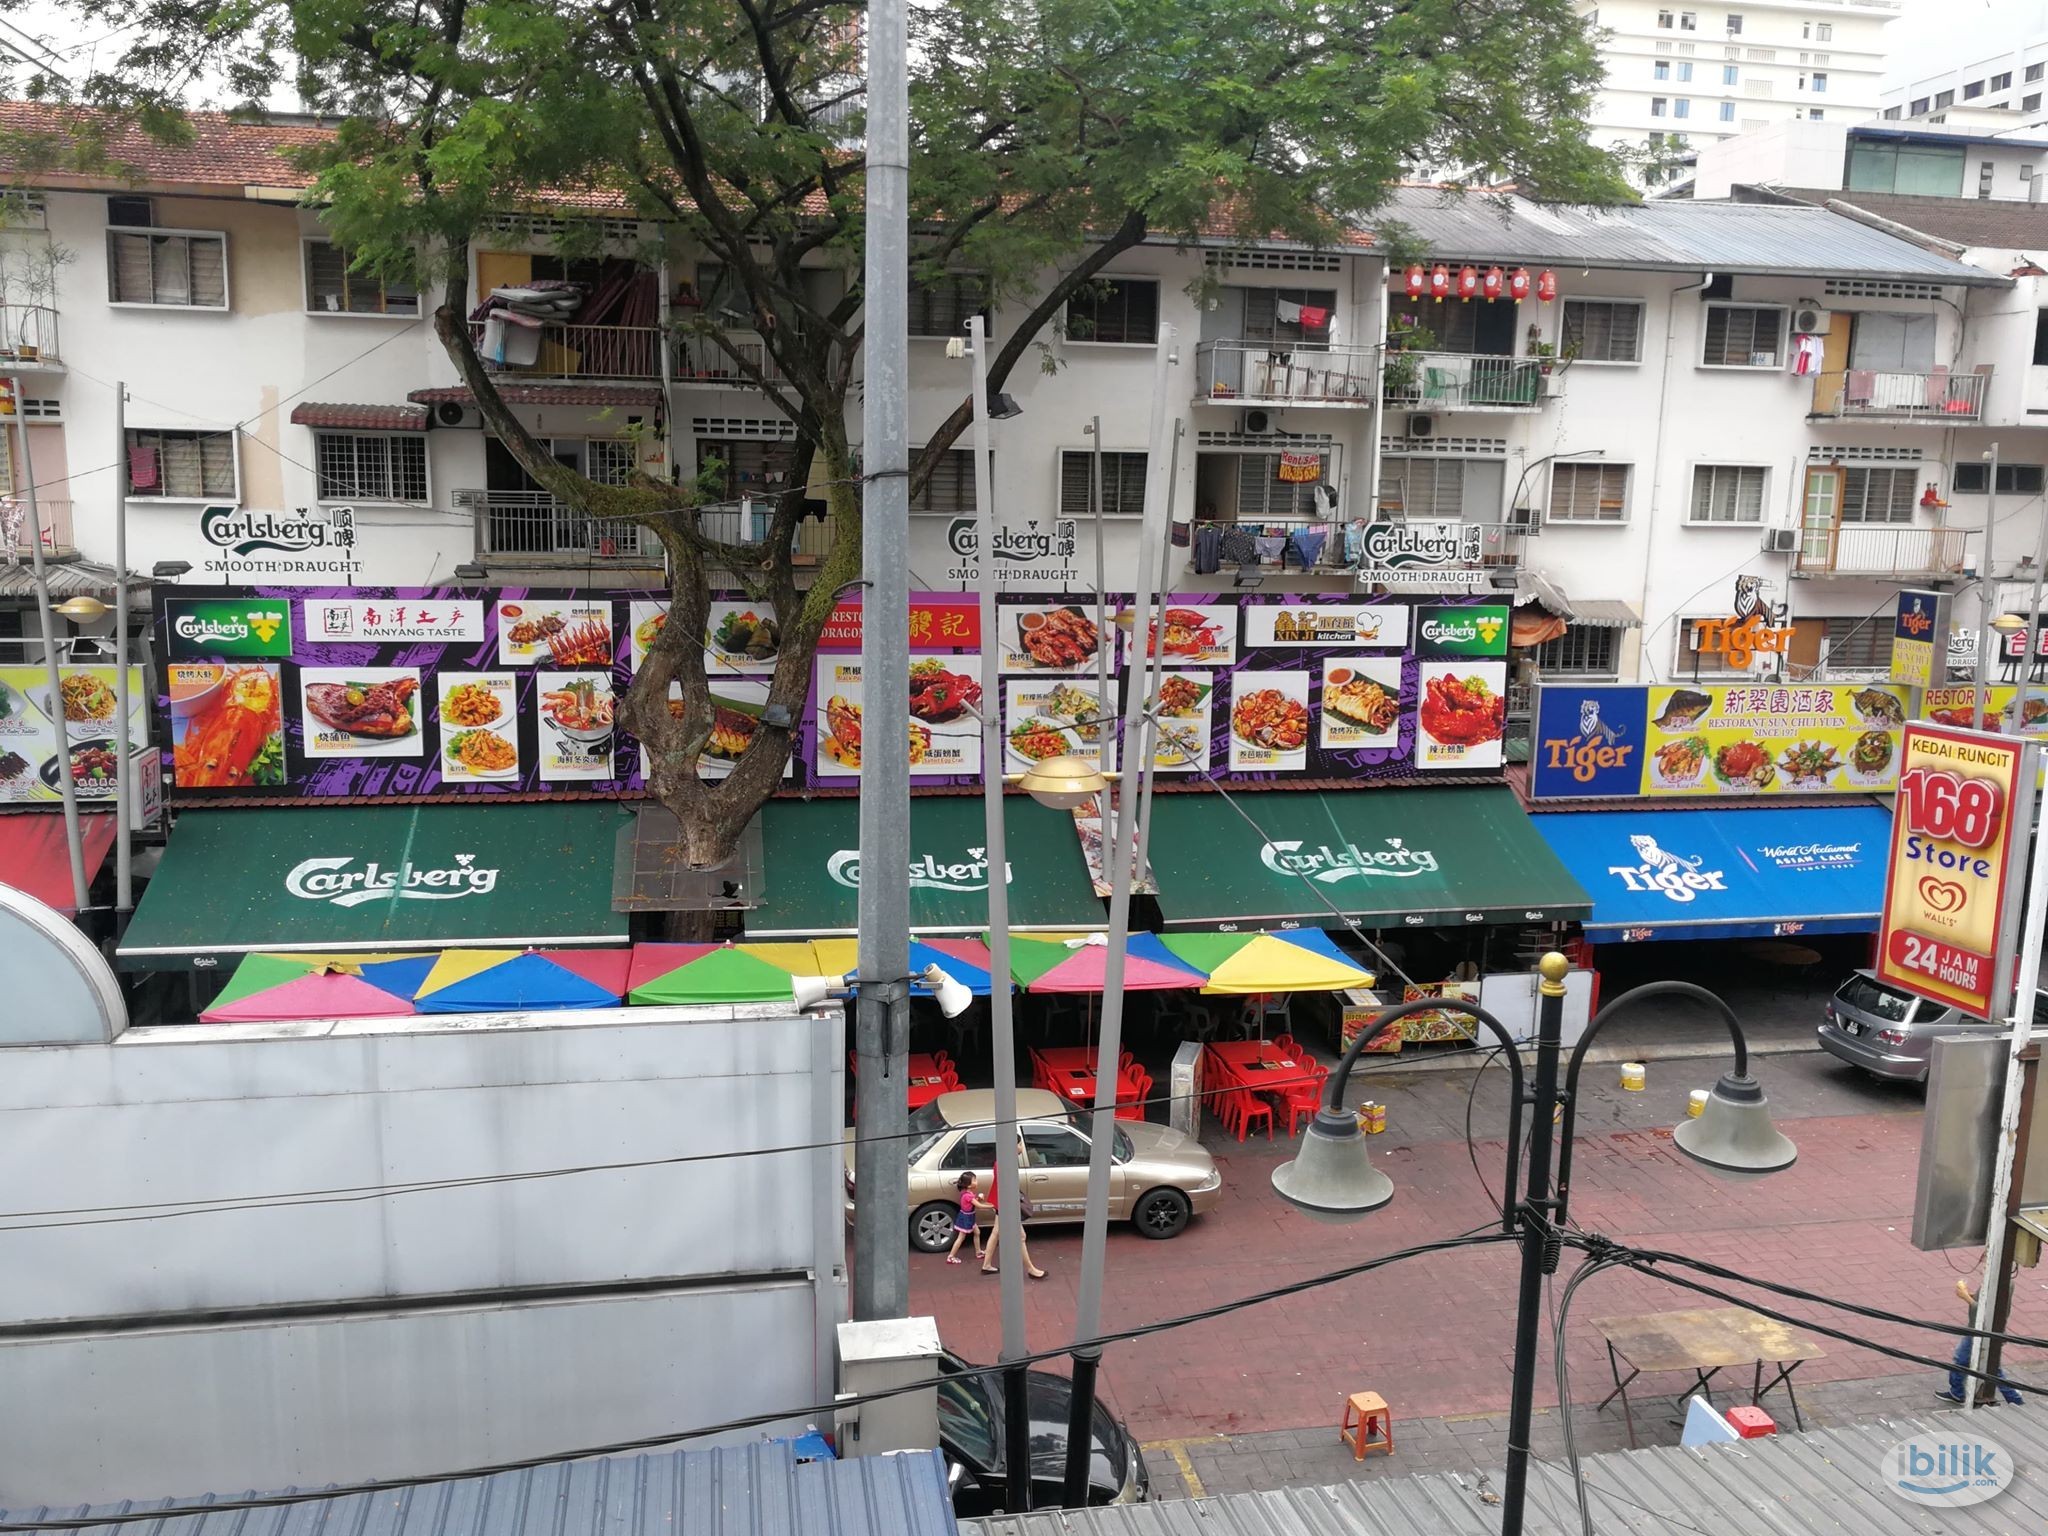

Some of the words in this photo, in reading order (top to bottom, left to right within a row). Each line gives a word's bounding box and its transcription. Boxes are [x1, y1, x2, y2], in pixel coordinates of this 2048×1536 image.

[201, 507, 325, 553] Carlsberg
[1364, 525, 1457, 565] Carlsberg
[205, 561, 276, 572] SMOOTH
[284, 561, 361, 572] DRAUGHT
[1013, 570, 1078, 580] DRAUGHT
[1362, 571, 1418, 582] SMOOTH
[1422, 572, 1482, 582] DRAUGHT
[175, 615, 248, 641] Carlsberg
[363, 606, 465, 628] 南洋土产
[1902, 613, 1932, 635] Tiger
[1276, 631, 1299, 640] XIN
[1302, 631, 1315, 640] JI
[1317, 631, 1352, 641] kitchen
[1422, 619, 1476, 643] Carlsberg
[1696, 615, 1796, 669] Tiger
[1724, 689, 1834, 713] 新翠園酒家
[1926, 689, 1992, 705] RESTORN
[1708, 719, 1766, 728] RESTORANT
[1769, 718, 1790, 727] SUN
[1791, 718, 1816, 727] CHUI
[1817, 717, 1845, 727] YUEN
[1545, 737, 1633, 782] Tiger
[1912, 738, 1951, 758] KEDAI
[1957, 749, 2009, 768] RUNCIT
[1901, 767, 2000, 848] 168
[1260, 839, 1440, 883] Carlsberg
[1757, 846, 1801, 858] World
[1776, 855, 1814, 865] ASIAN
[1906, 836, 1991, 878] Store
[286, 854, 499, 907] Carlsberg
[1608, 863, 1728, 902] Tiger
[1781, 922, 1804, 935] Tiger
[1924, 911, 1957, 927] WALL'S
[1630, 928, 1653, 940] Tiger
[1903, 936, 1938, 975] 24
[1942, 950, 1978, 973] JAM
[1939, 966, 1977, 991] HOURS
